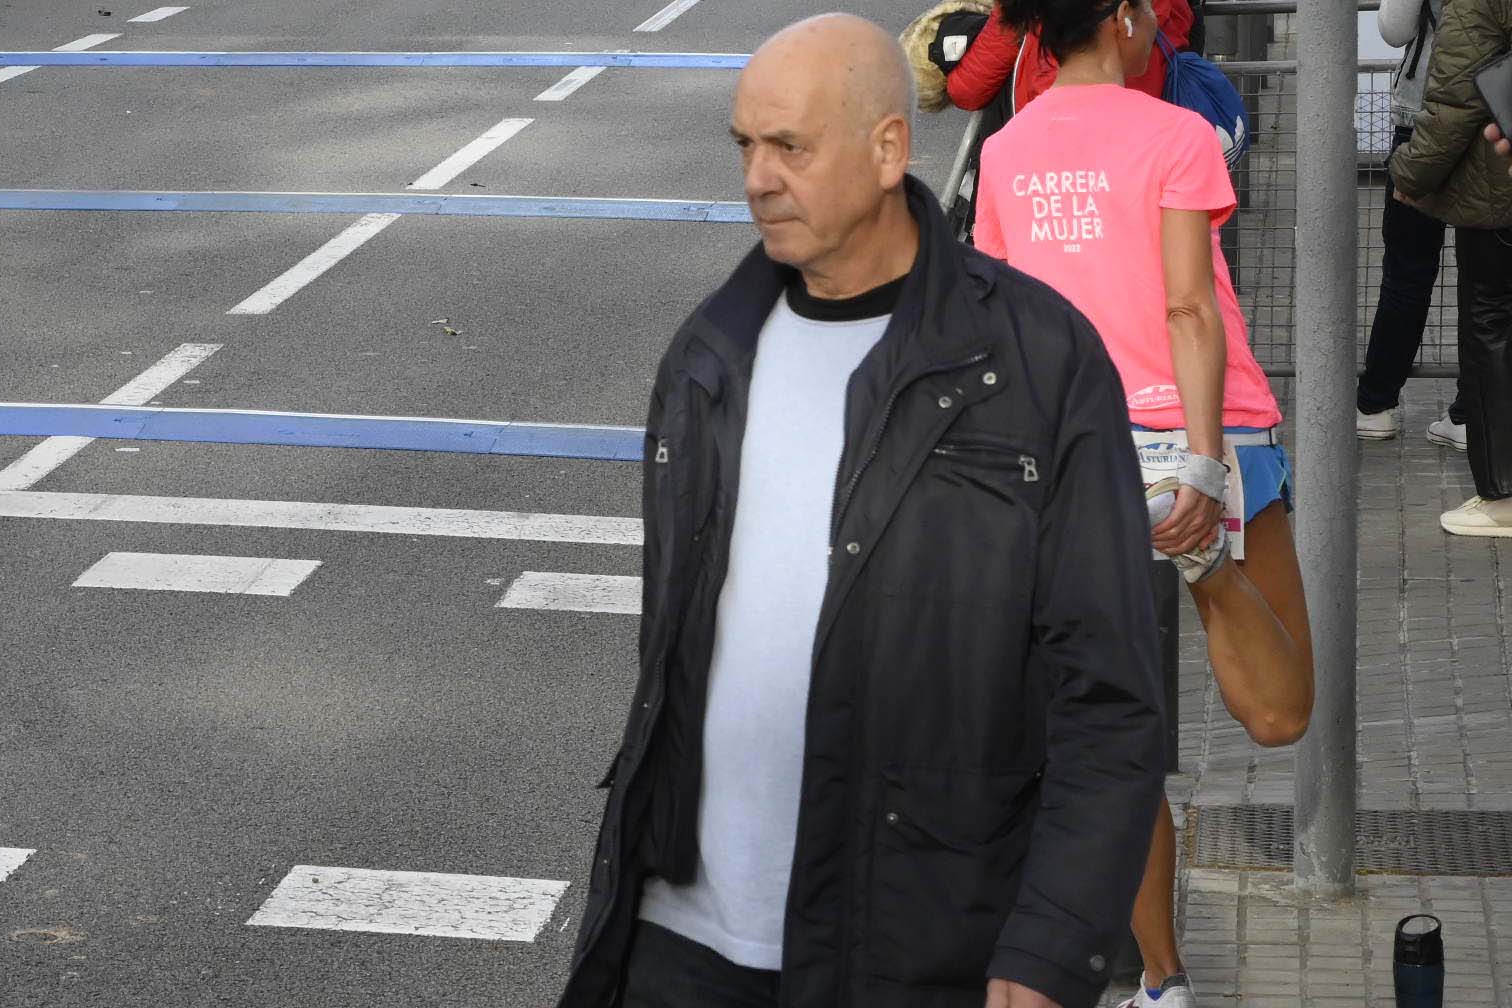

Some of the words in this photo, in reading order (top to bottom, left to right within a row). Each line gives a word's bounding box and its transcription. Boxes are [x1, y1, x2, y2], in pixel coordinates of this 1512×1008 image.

[1013, 170, 1110, 197] CARRERA
[1032, 196, 1062, 218] DE
[1072, 195, 1099, 217] LA
[1031, 218, 1103, 242] MUJER
